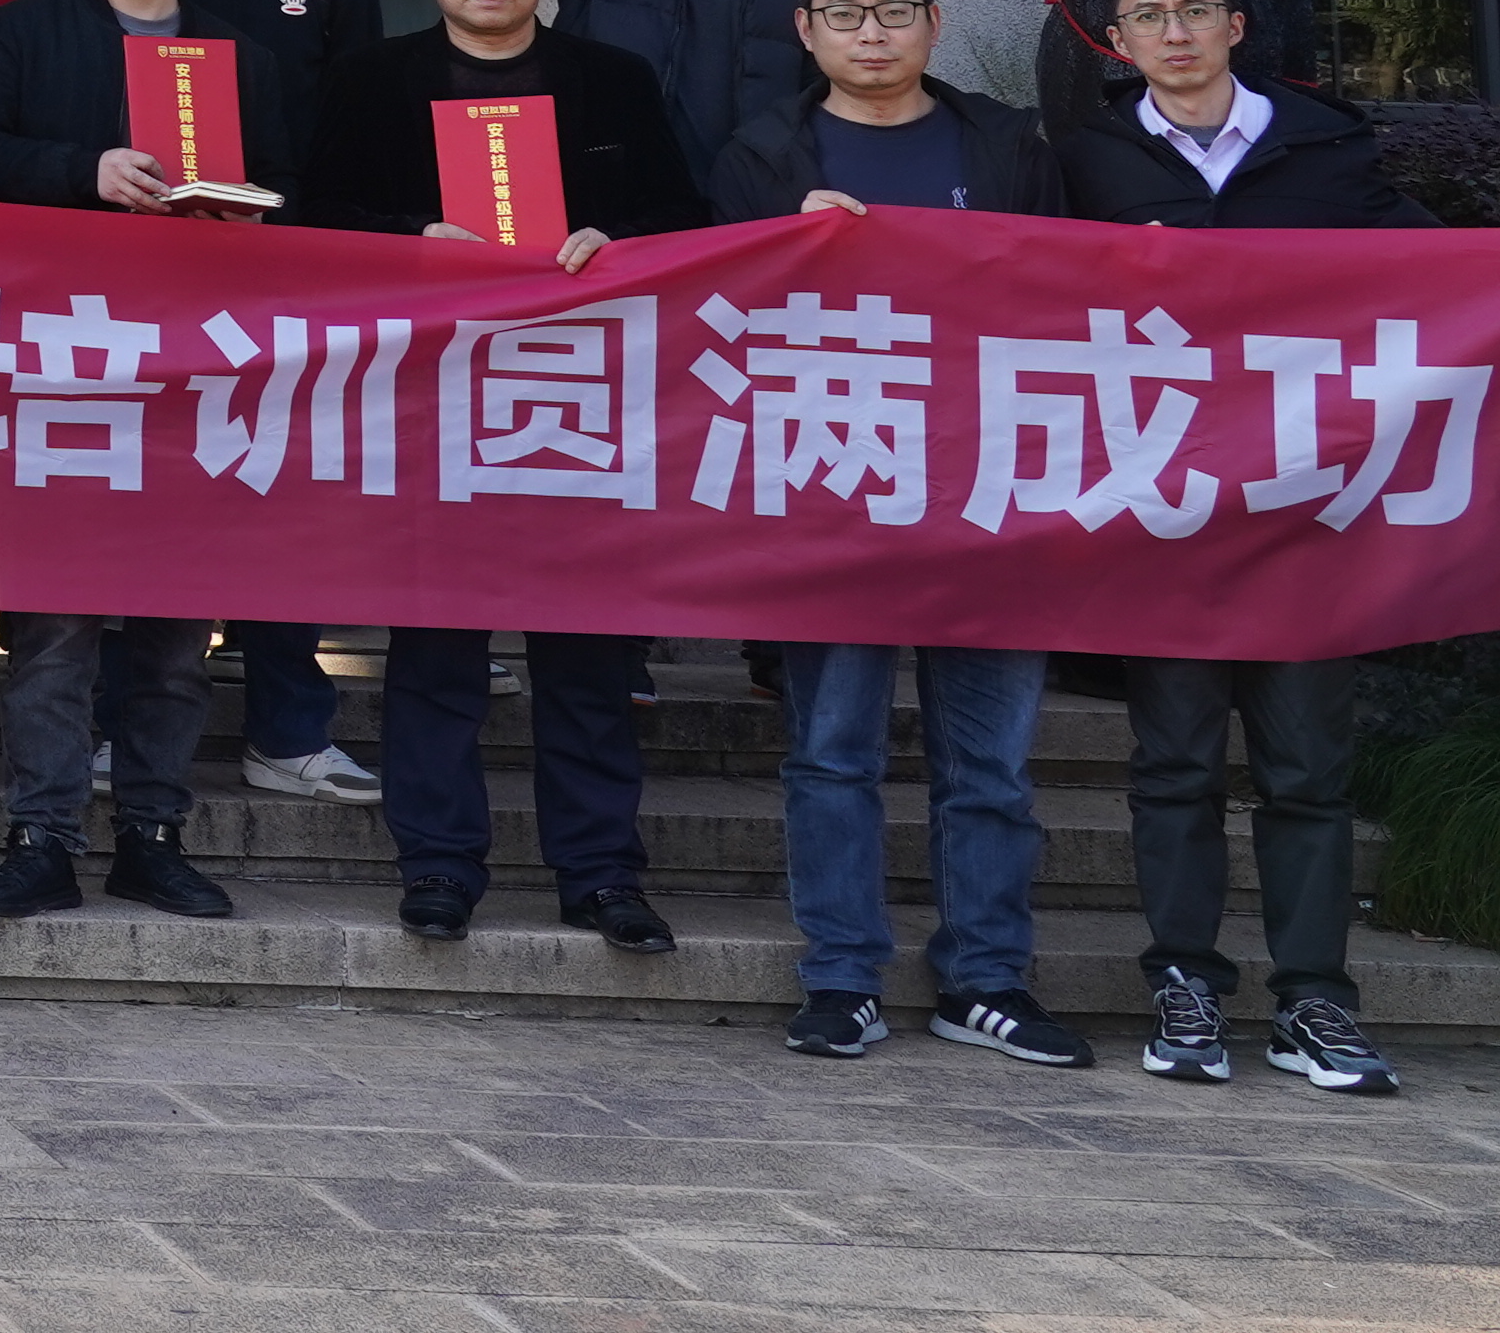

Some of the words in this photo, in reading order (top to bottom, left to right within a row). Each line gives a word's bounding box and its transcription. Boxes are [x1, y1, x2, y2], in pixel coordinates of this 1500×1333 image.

[486, 123, 516, 245] 安装技师等级证书
